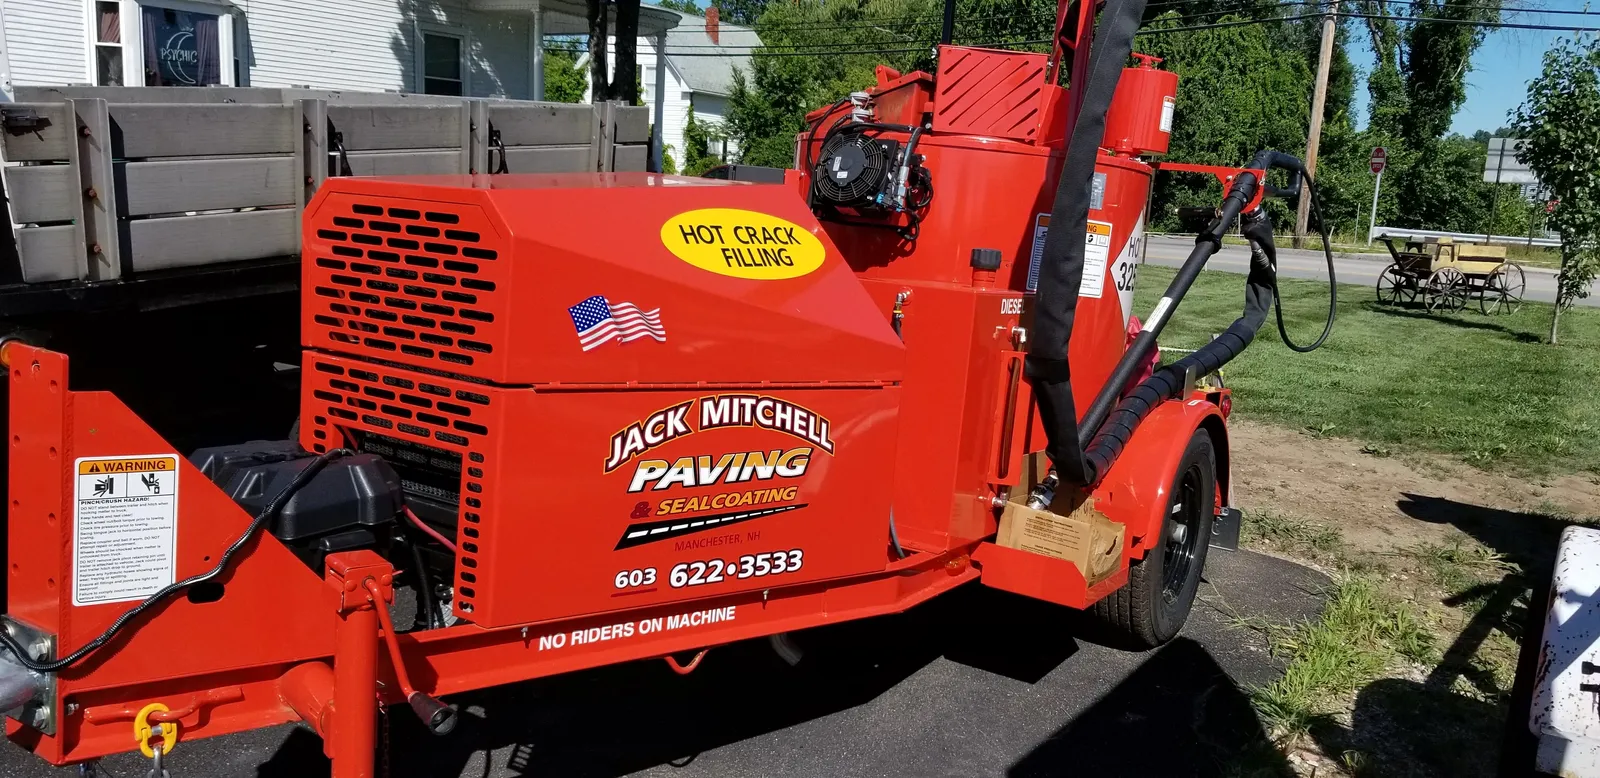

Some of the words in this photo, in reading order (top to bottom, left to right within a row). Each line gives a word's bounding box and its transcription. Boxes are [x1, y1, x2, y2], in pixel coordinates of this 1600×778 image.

[161, 47, 198, 63] PSYCHIC
[678, 224, 725, 244] HOT
[733, 225, 801, 245] CRACK
[720, 247, 794, 268] FILLING
[1127, 236, 1142, 258] HO
[1000, 298, 1025, 315] DIESEL
[603, 398, 697, 475] JACK
[698, 393, 835, 456] MITCHELL
[103, 460, 166, 472] WARNING
[627, 448, 813, 493] PAVING
[630, 501, 652, 520] &
[656, 486, 799, 516] SEALCOATING
[674, 534, 744, 551] MANCHESTER,
[746, 530, 761, 542] NH
[613, 567, 658, 589] 603
[538, 632, 567, 651] NO
[570, 621, 636, 646] RIDERS
[638, 617, 664, 636] ON
[666, 605, 737, 631] MACHINE
